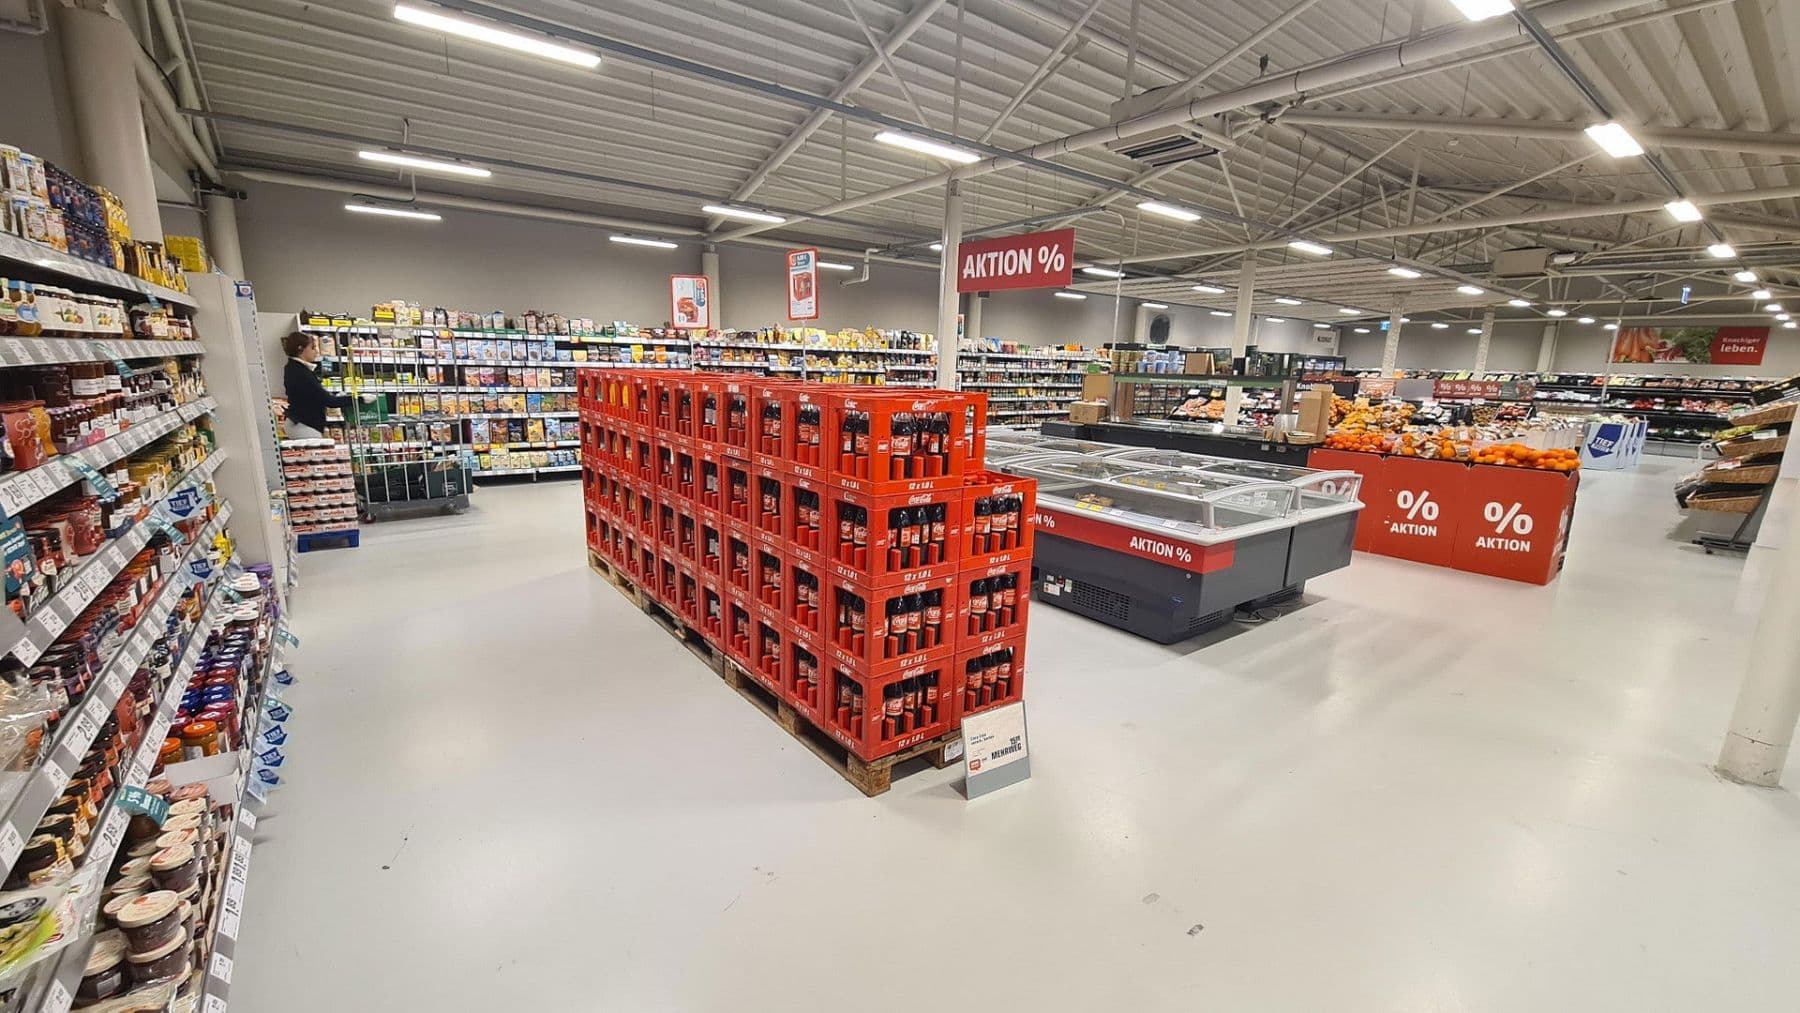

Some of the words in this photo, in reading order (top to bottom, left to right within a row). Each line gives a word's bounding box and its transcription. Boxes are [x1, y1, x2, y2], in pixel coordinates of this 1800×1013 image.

[962, 248, 1032, 279] AKTION
[1038, 244, 1065, 274] %
[1720, 344, 1758, 352] leben.
[908, 493, 934, 505] Coca-Cola
[1397, 490, 1440, 521] %
[1043, 515, 1055, 528] %
[1484, 502, 1533, 535] %
[1390, 523, 1437, 537] AKTION
[1130, 536, 1174, 558] AKTION
[1176, 547, 1191, 562] %
[1476, 536, 1531, 552] AKTION
[987, 565, 1007, 576] Coca-Cola
[904, 581, 929, 594] Coca-Cola
[983, 642, 1004, 654] Coca-Cola
[991, 743, 1022, 760] MEHRWEG
